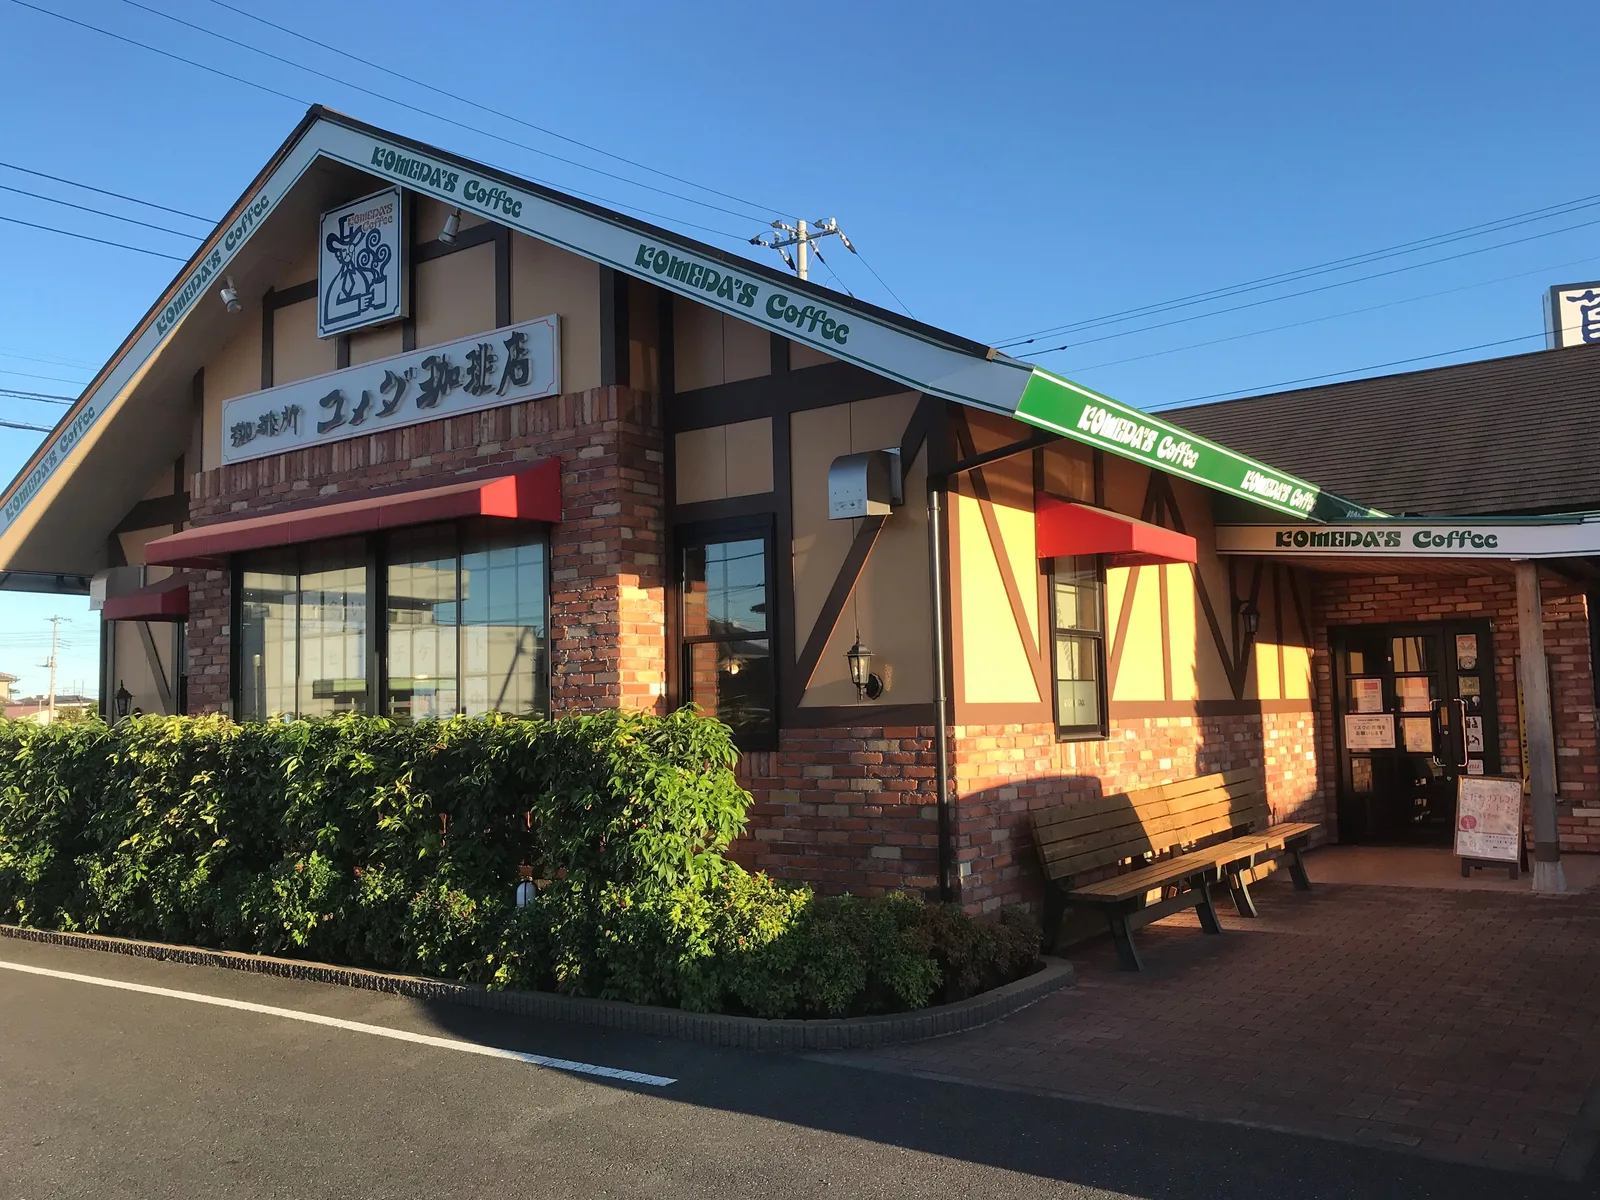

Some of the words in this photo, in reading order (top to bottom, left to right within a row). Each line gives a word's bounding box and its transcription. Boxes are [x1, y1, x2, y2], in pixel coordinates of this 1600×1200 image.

[371, 146, 459, 194] KOMEDA'S
[463, 179, 523, 218] Coffee
[156, 249, 222, 336] KOMEDA'S
[224, 195, 270, 252] Coffee
[634, 243, 759, 308] KOMEDA'S
[765, 293, 850, 345] Coffee
[317, 331, 532, 434] コメダ珈琲店
[1076, 404, 1159, 453] KOMEDA'S
[1156, 435, 1200, 469] Coffee
[5, 450, 58, 522] KOMEDA'S
[1275, 530, 1401, 548] KOMEDA'S
[1412, 530, 1498, 549] Coffee
